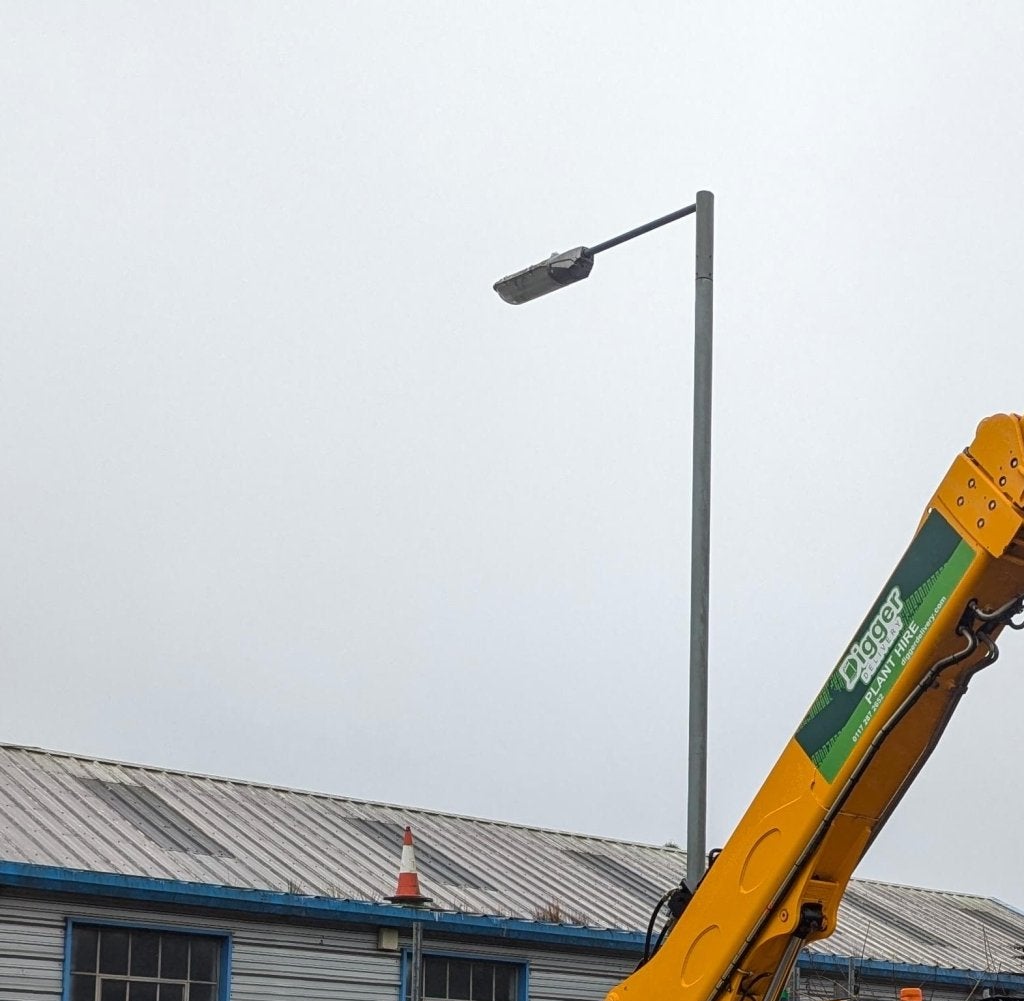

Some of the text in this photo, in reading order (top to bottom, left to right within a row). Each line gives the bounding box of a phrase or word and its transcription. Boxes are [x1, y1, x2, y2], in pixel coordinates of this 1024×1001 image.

[841, 588, 902, 689] Digger
[864, 621, 900, 680] DELIVERY
[865, 621, 920, 704] PLANT HIRE
[853, 723, 864, 742] 0117
[863, 710, 873, 727] 287
